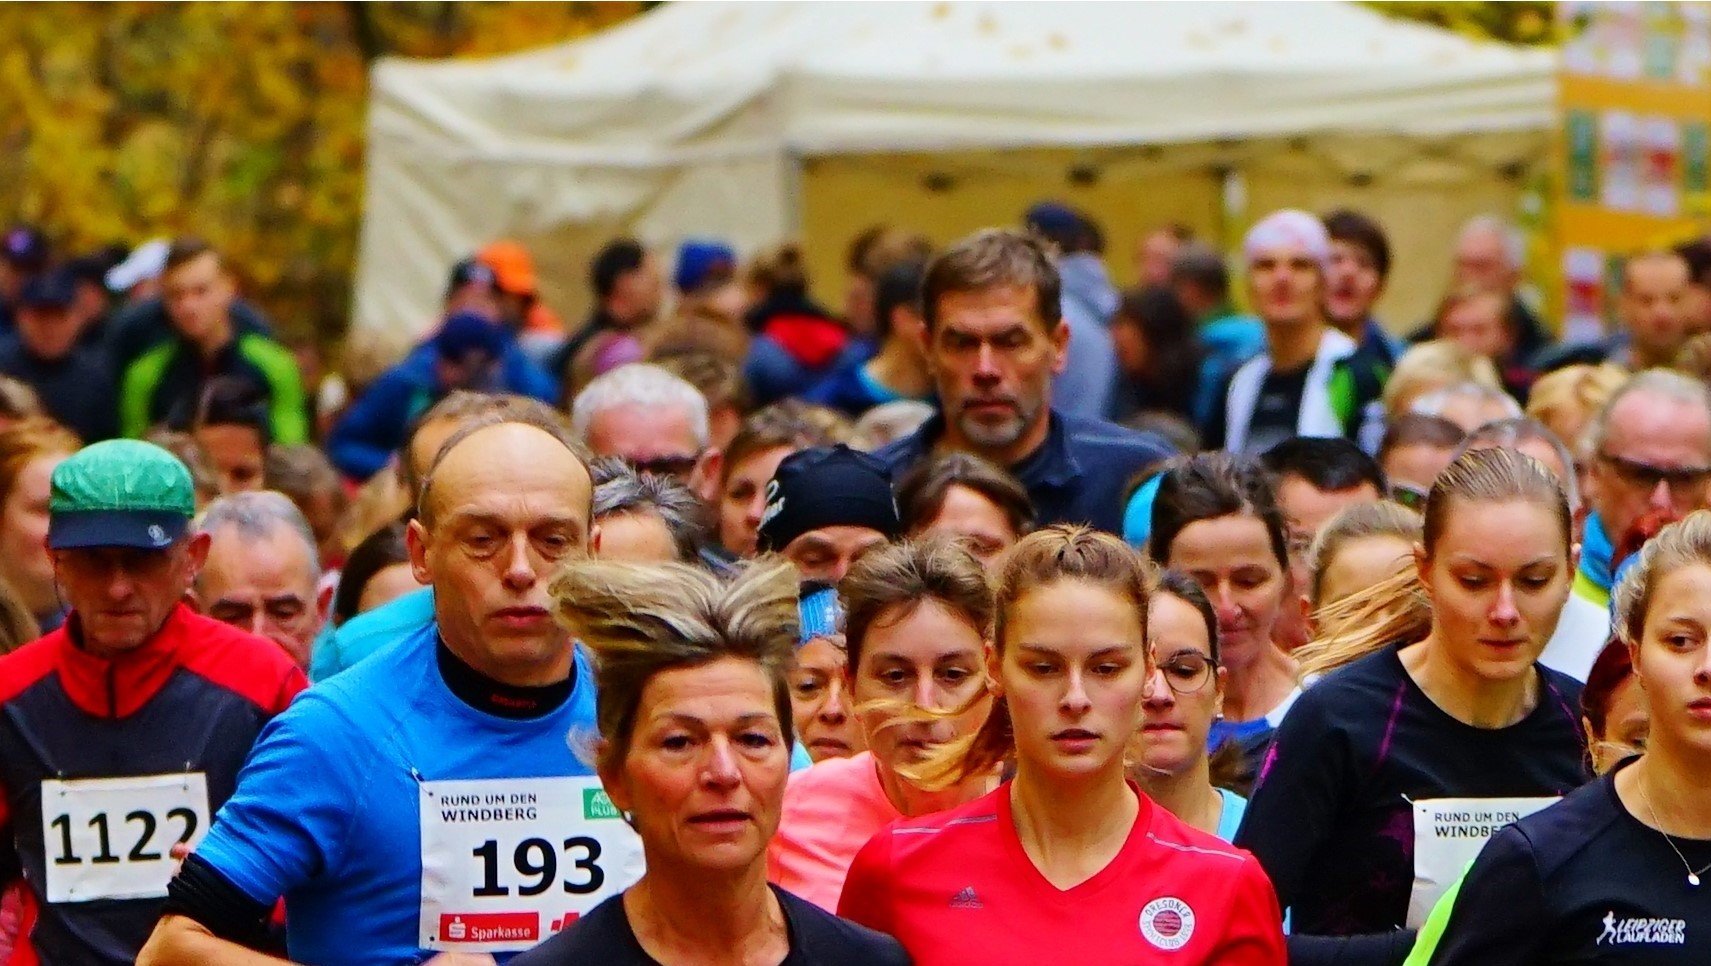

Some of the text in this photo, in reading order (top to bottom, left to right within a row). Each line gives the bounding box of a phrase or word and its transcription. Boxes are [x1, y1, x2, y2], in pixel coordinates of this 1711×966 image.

[441, 793, 537, 806] RUND UM DEN
[441, 807, 537, 822] WINDBERG
[1435, 812, 1519, 823] RUND UM DEN
[51, 807, 198, 863] 1122
[1435, 825, 1501, 838] WINDBE
[473, 836, 605, 896] 193
[1617, 918, 1686, 932] LEIPZIGER
[471, 926, 531, 941] Sparkasse
[1617, 931, 1685, 944] LAUFLADEN
